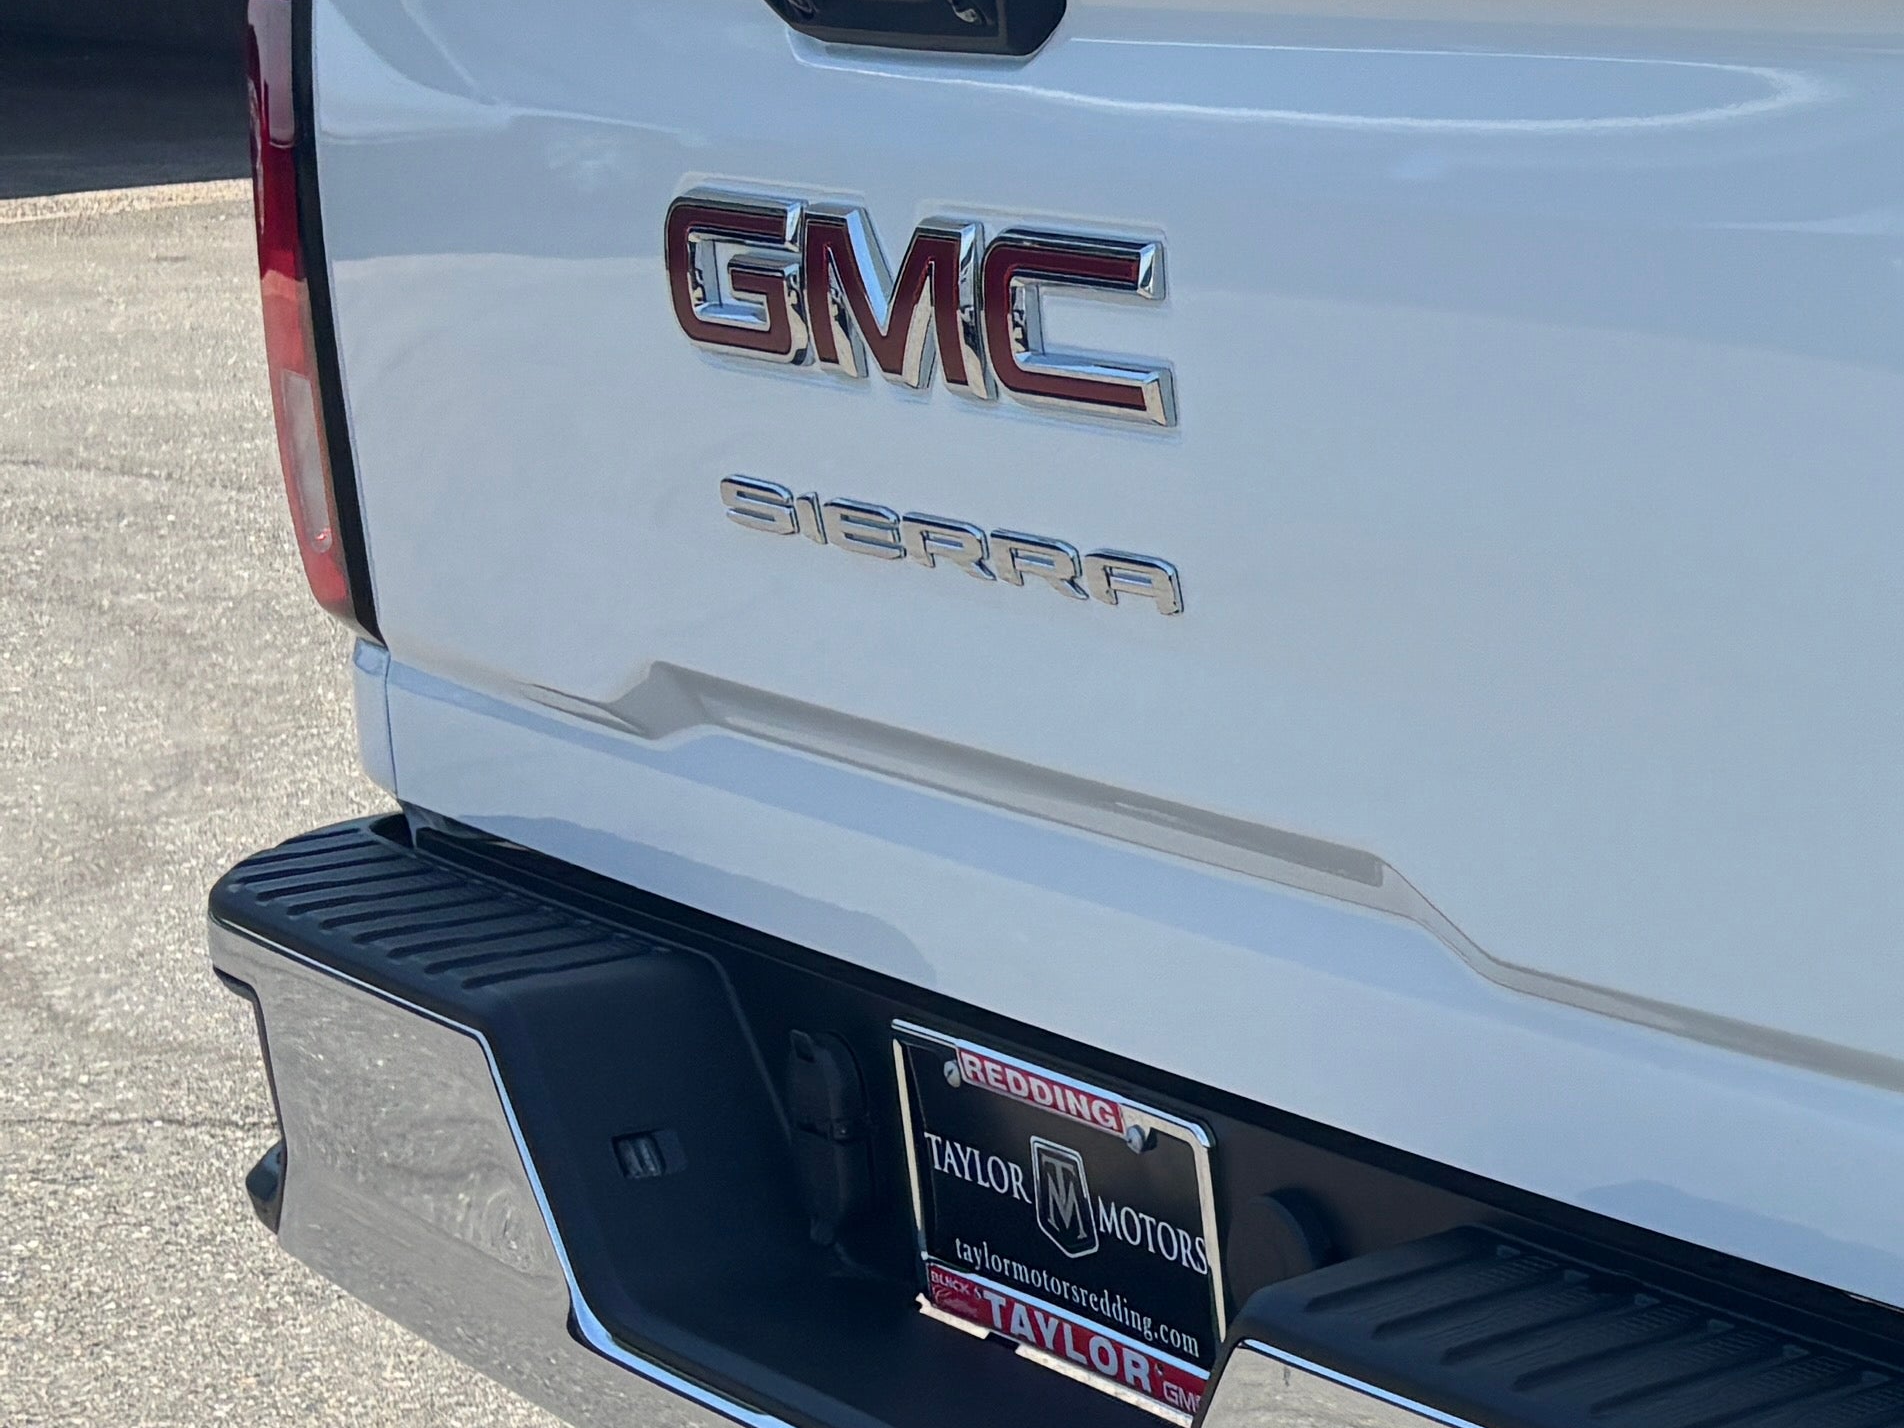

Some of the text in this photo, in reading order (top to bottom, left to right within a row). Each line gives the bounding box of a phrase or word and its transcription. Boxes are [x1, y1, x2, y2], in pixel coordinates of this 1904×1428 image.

[664, 186, 1178, 428] GMC
[720, 474, 1184, 616] SIERRA
[962, 1053, 1119, 1130] REDDING
[924, 1131, 1209, 1275] TAYLOR MOTORS
[955, 1237, 1200, 1358] taylormotorsredding.com
[983, 1289, 1152, 1394] TAYLOR
